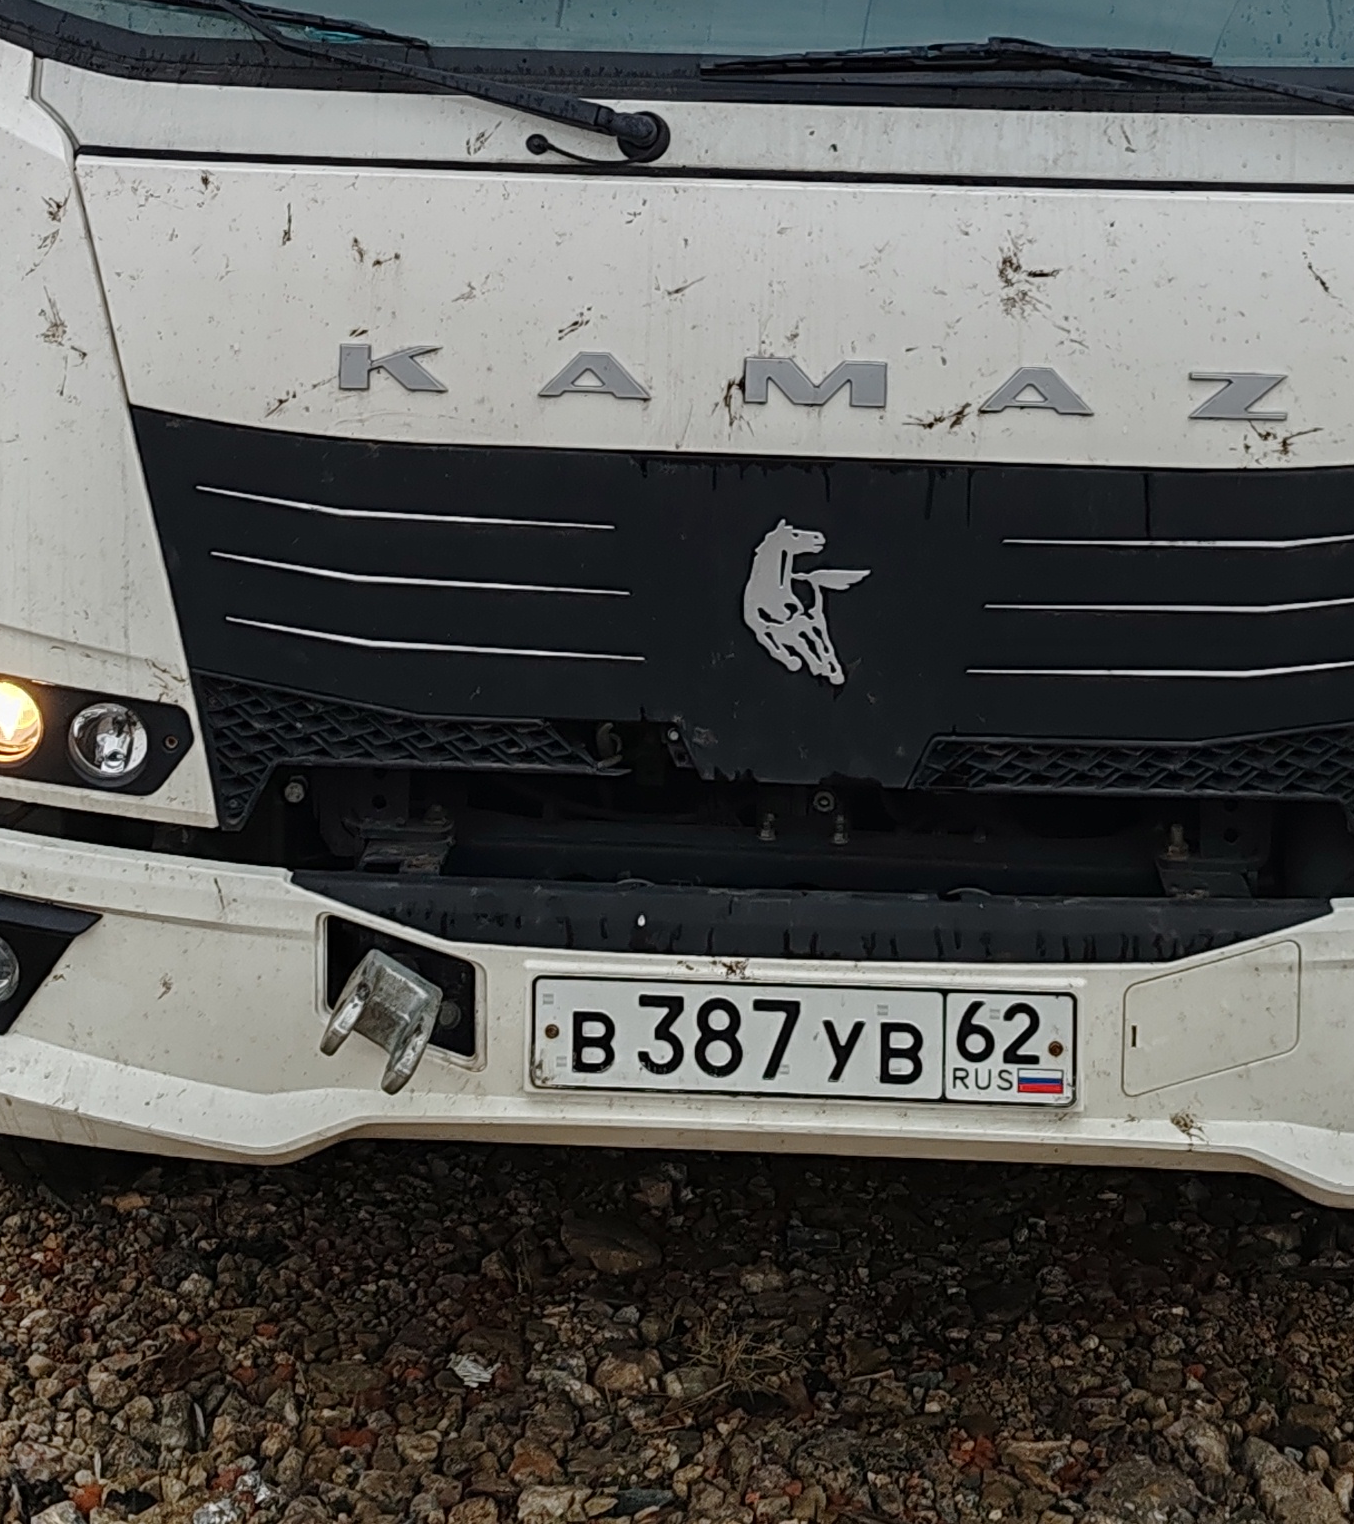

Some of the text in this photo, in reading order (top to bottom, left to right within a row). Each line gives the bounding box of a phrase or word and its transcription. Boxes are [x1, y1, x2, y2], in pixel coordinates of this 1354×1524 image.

[338, 342, 1289, 422] KAMAZ
[956, 1000, 1040, 1065] 62
[952, 1067, 1013, 1091] RUS
